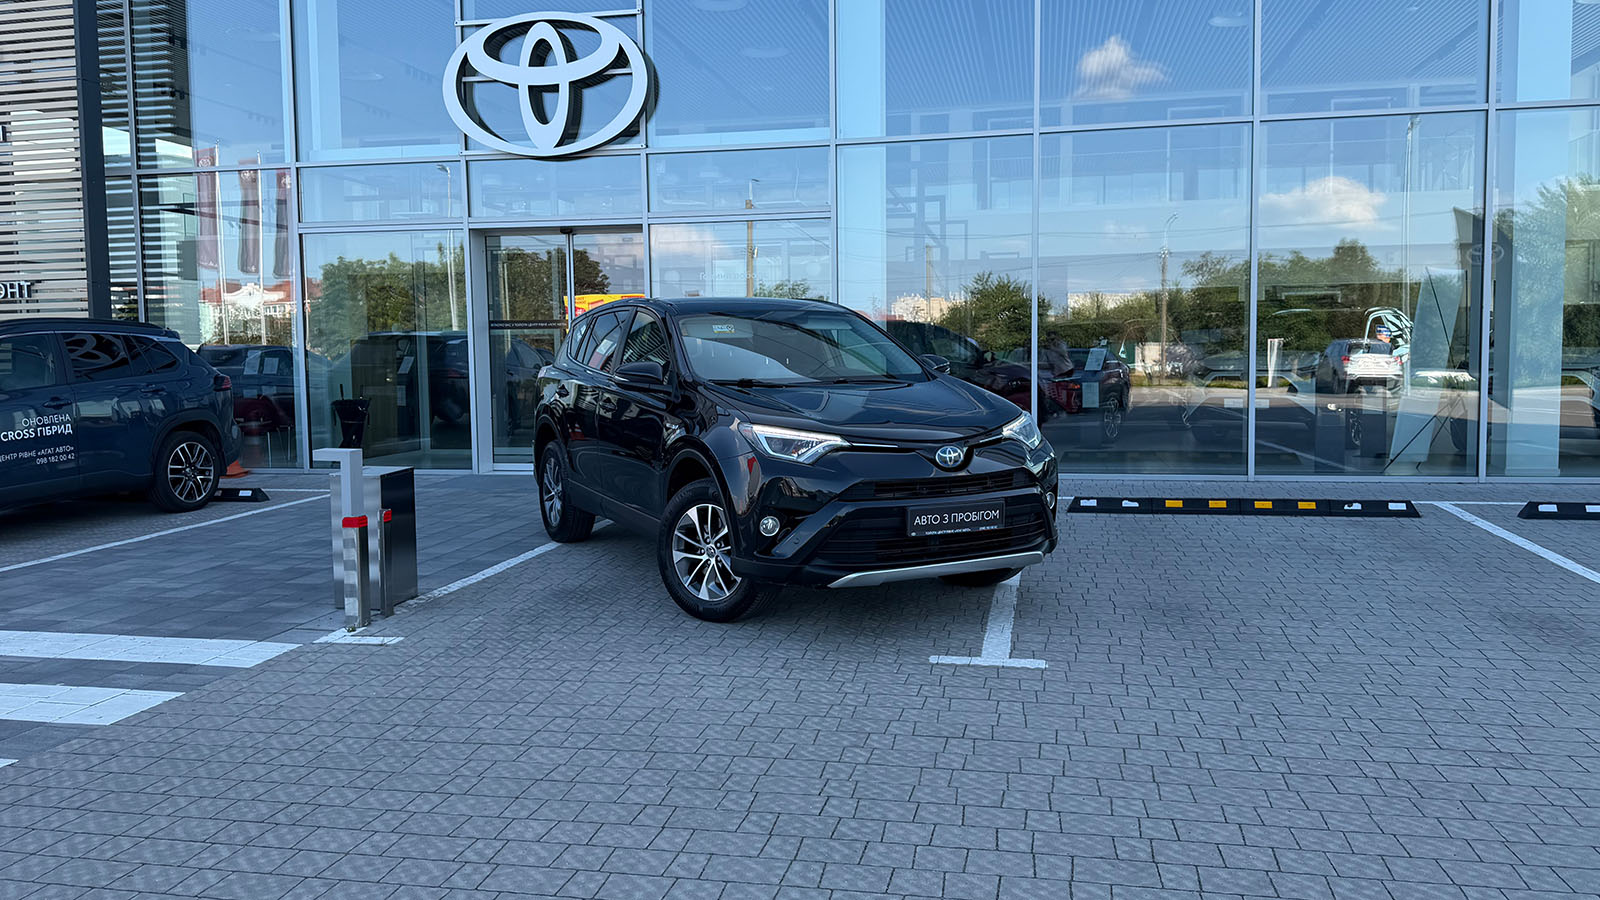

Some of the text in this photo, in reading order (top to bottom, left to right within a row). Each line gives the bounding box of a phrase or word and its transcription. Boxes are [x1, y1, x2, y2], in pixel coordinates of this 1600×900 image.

[22, 414, 71, 427] ОНОВЛЕНА
[0, 423, 73, 442] CROSS ГІБРИД
[67, 452, 75, 460] 42
[913, 514, 941, 526] АВТО
[951, 510, 999, 523] ПРОБІГОМ
